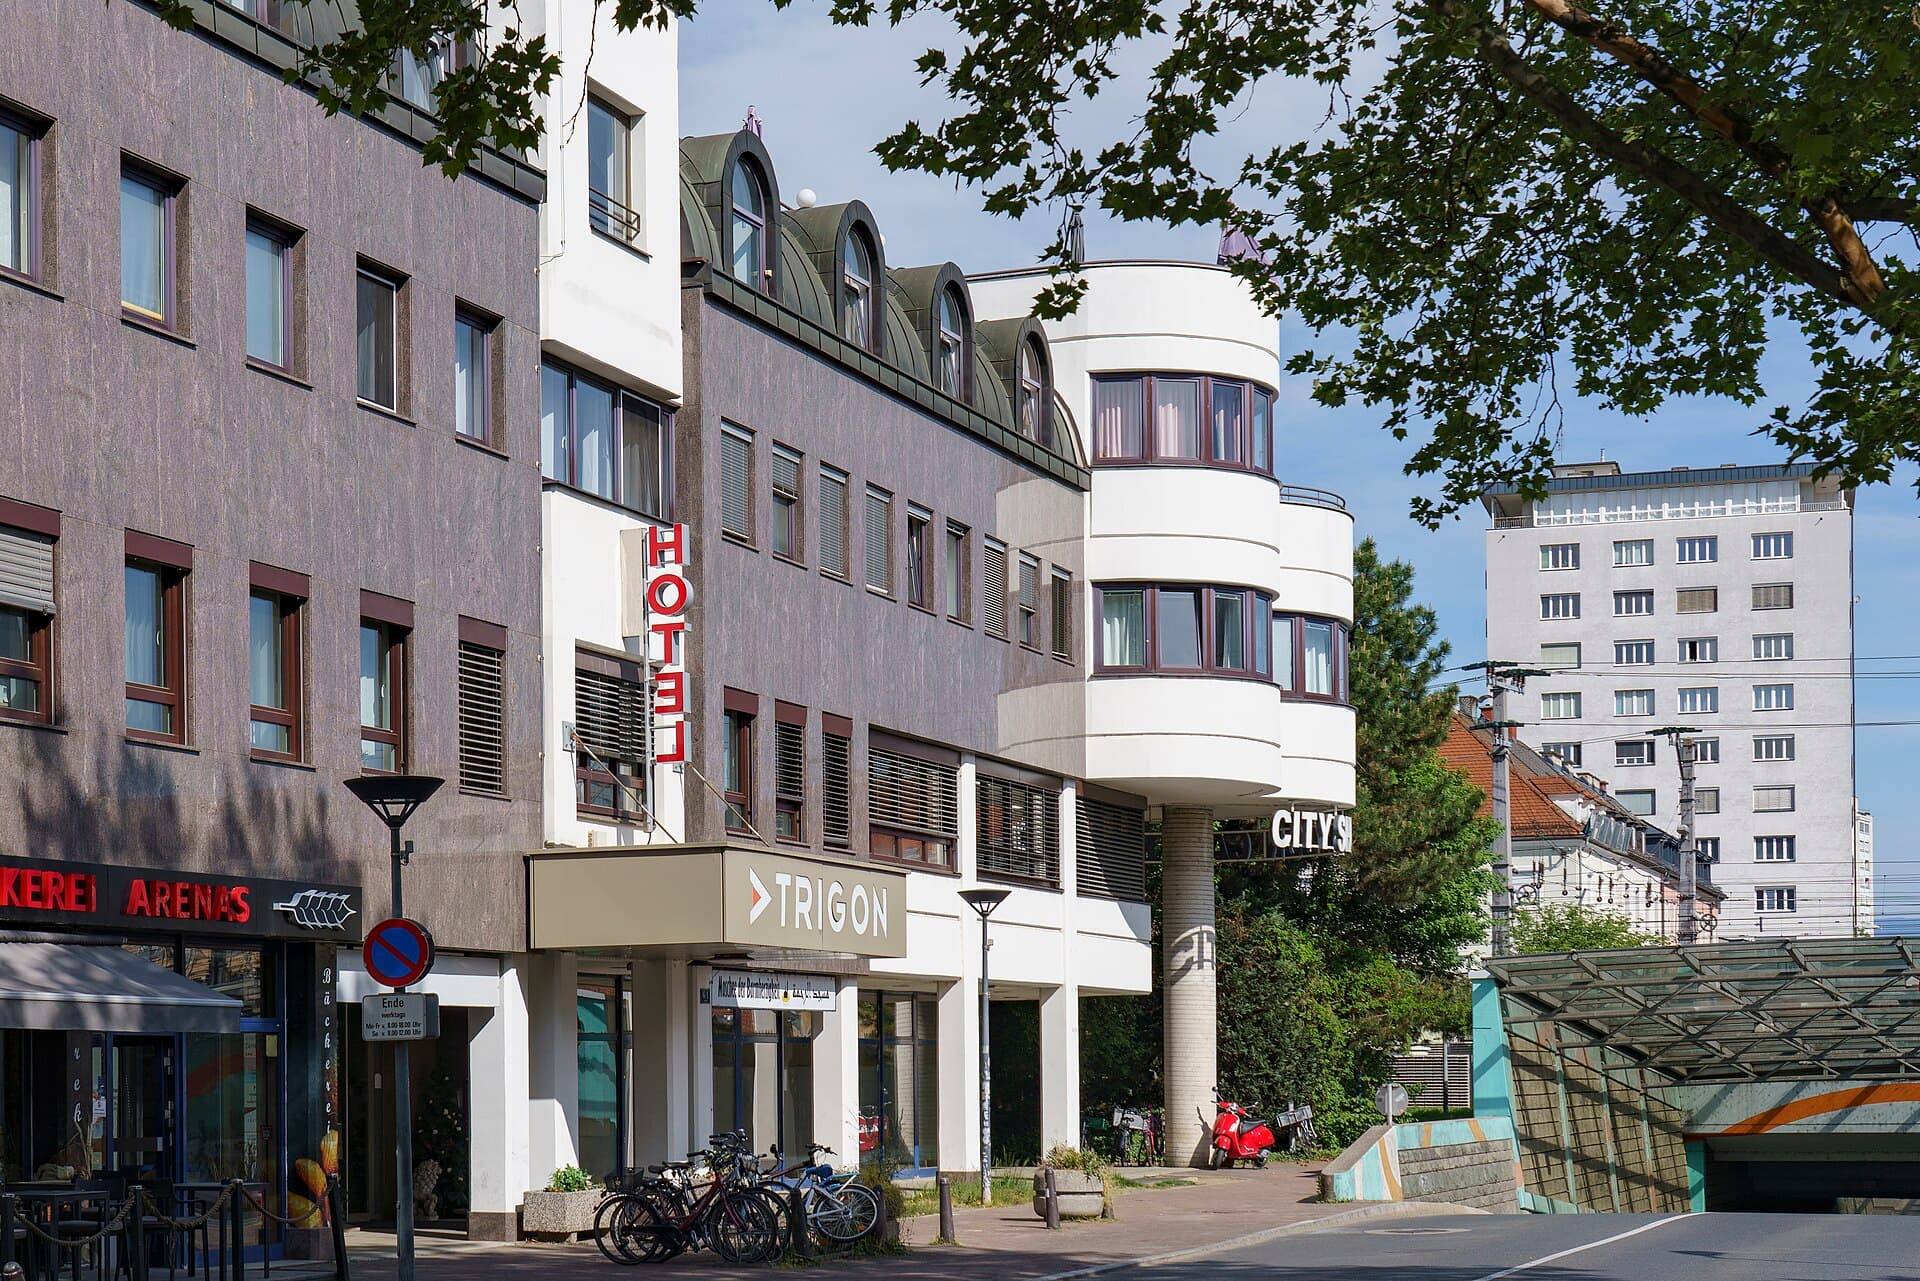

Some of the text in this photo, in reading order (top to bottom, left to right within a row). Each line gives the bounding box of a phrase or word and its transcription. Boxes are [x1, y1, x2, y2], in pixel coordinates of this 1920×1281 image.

[0, 867, 251, 923] KEREI ARENAS
[775, 872, 888, 939] TRIGON
[382, 998, 405, 1008] Ende
[322, 967, 332, 1134] Bäckerei
